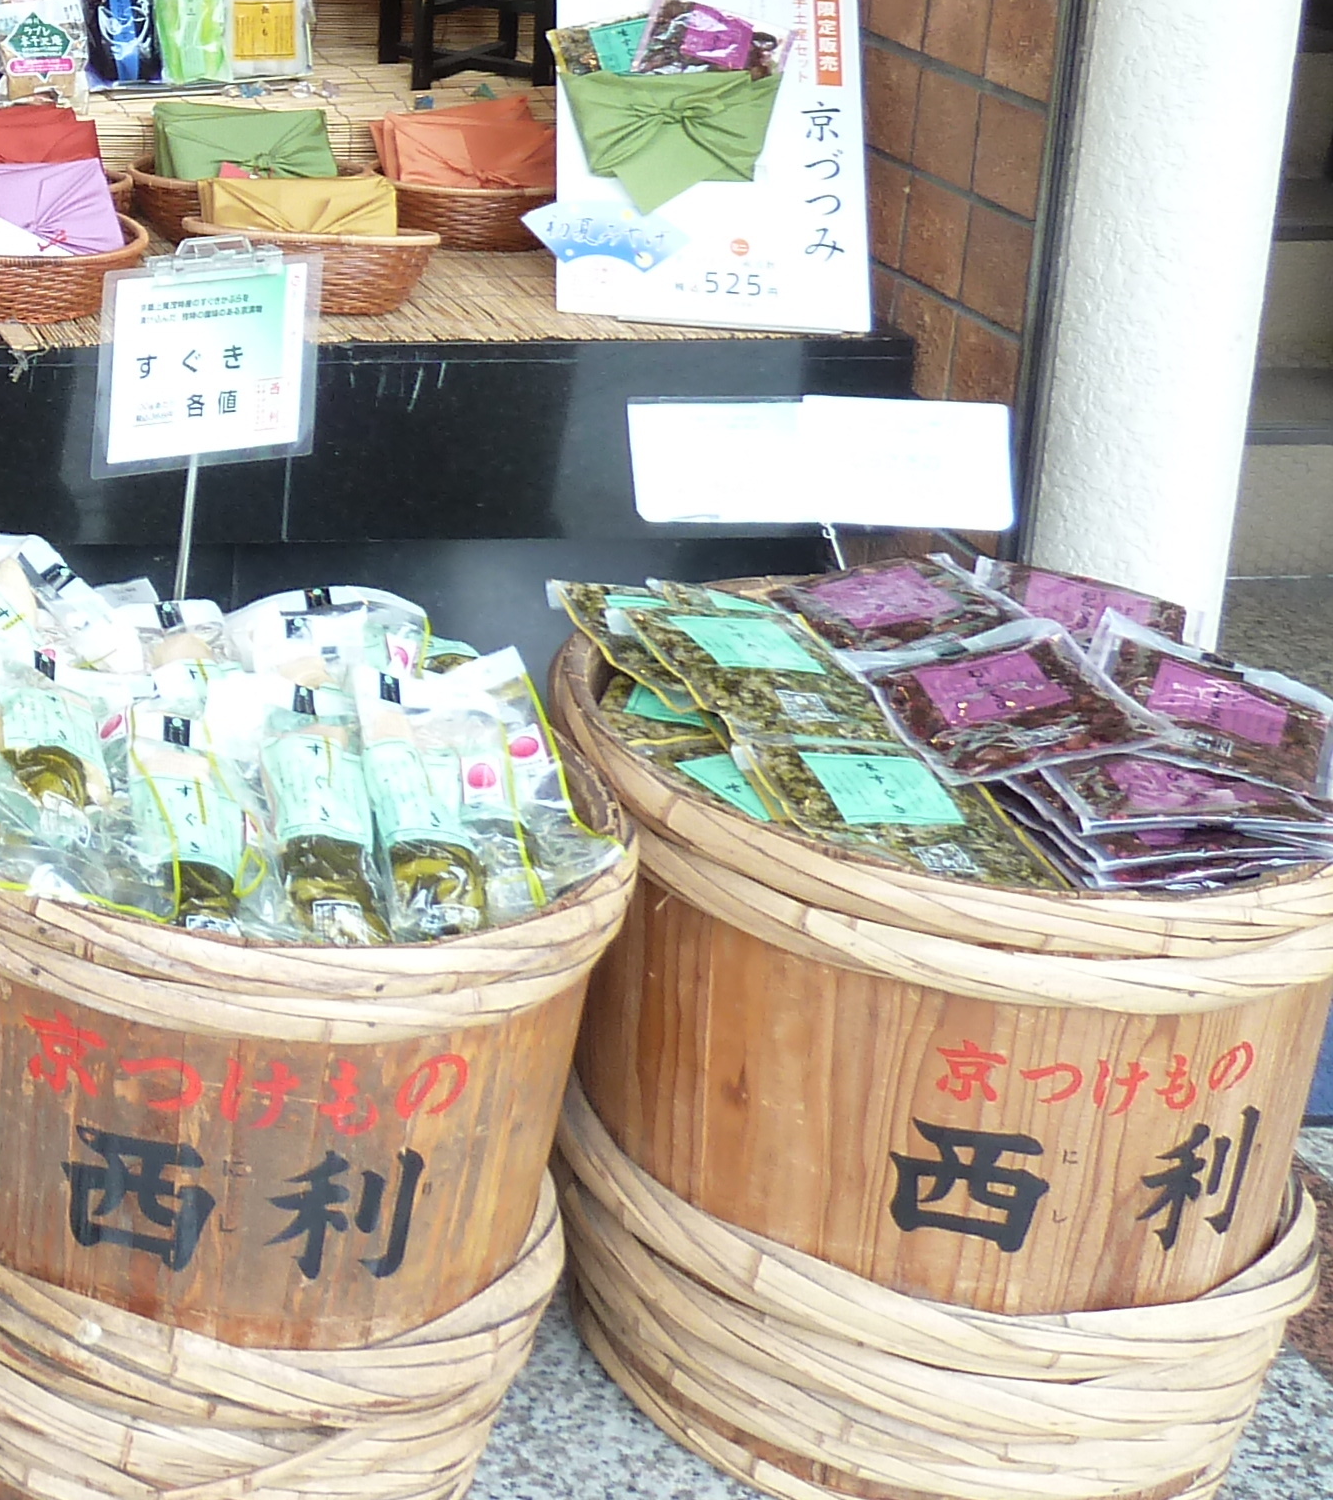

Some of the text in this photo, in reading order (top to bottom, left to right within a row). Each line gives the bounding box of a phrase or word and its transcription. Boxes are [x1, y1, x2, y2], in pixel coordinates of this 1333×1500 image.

[799, 100, 846, 263] 京づつみ
[136, 344, 244, 380] すぐき
[185, 389, 239, 419] 各値
[22, 1007, 469, 1137] 京つけもの
[935, 1038, 1255, 1118] 京つけもの
[61, 1124, 427, 1280] 西利
[889, 1104, 1261, 1254] 西利
